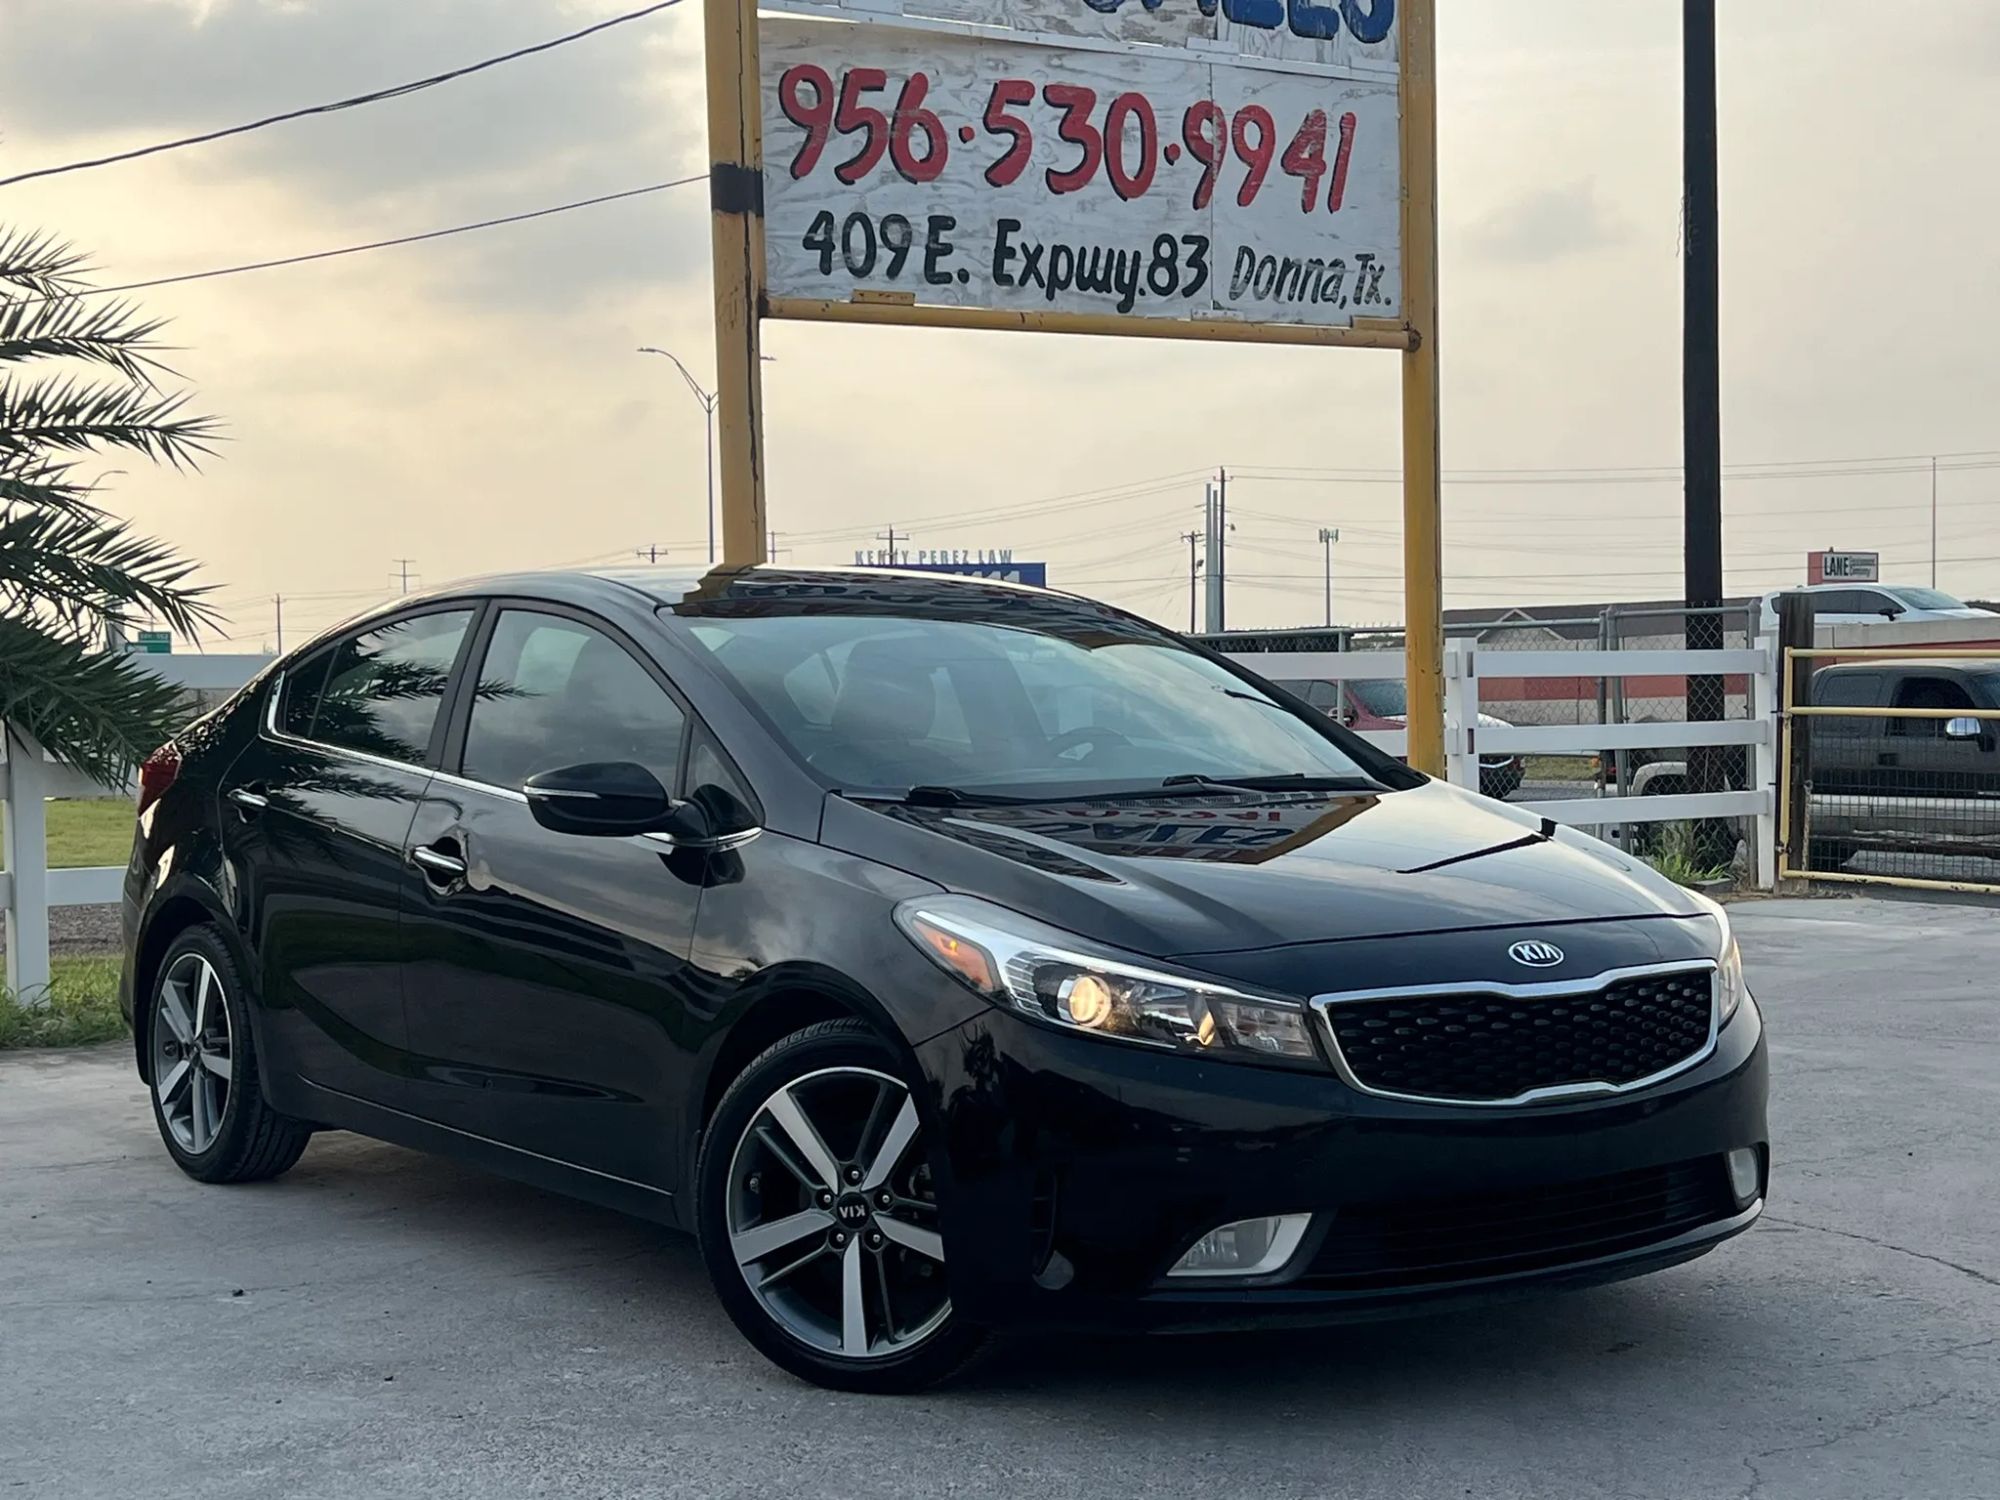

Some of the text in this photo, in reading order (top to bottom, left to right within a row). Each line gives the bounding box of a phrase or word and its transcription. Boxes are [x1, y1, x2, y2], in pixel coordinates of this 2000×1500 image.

[803, 210, 912, 280] 409
[919, 550, 969, 565] PEREZ
[978, 549, 1012, 565] LAW
[1824, 556, 1849, 576] LANE
[1514, 942, 1561, 962] KIA
[839, 1204, 866, 1219] KIA
